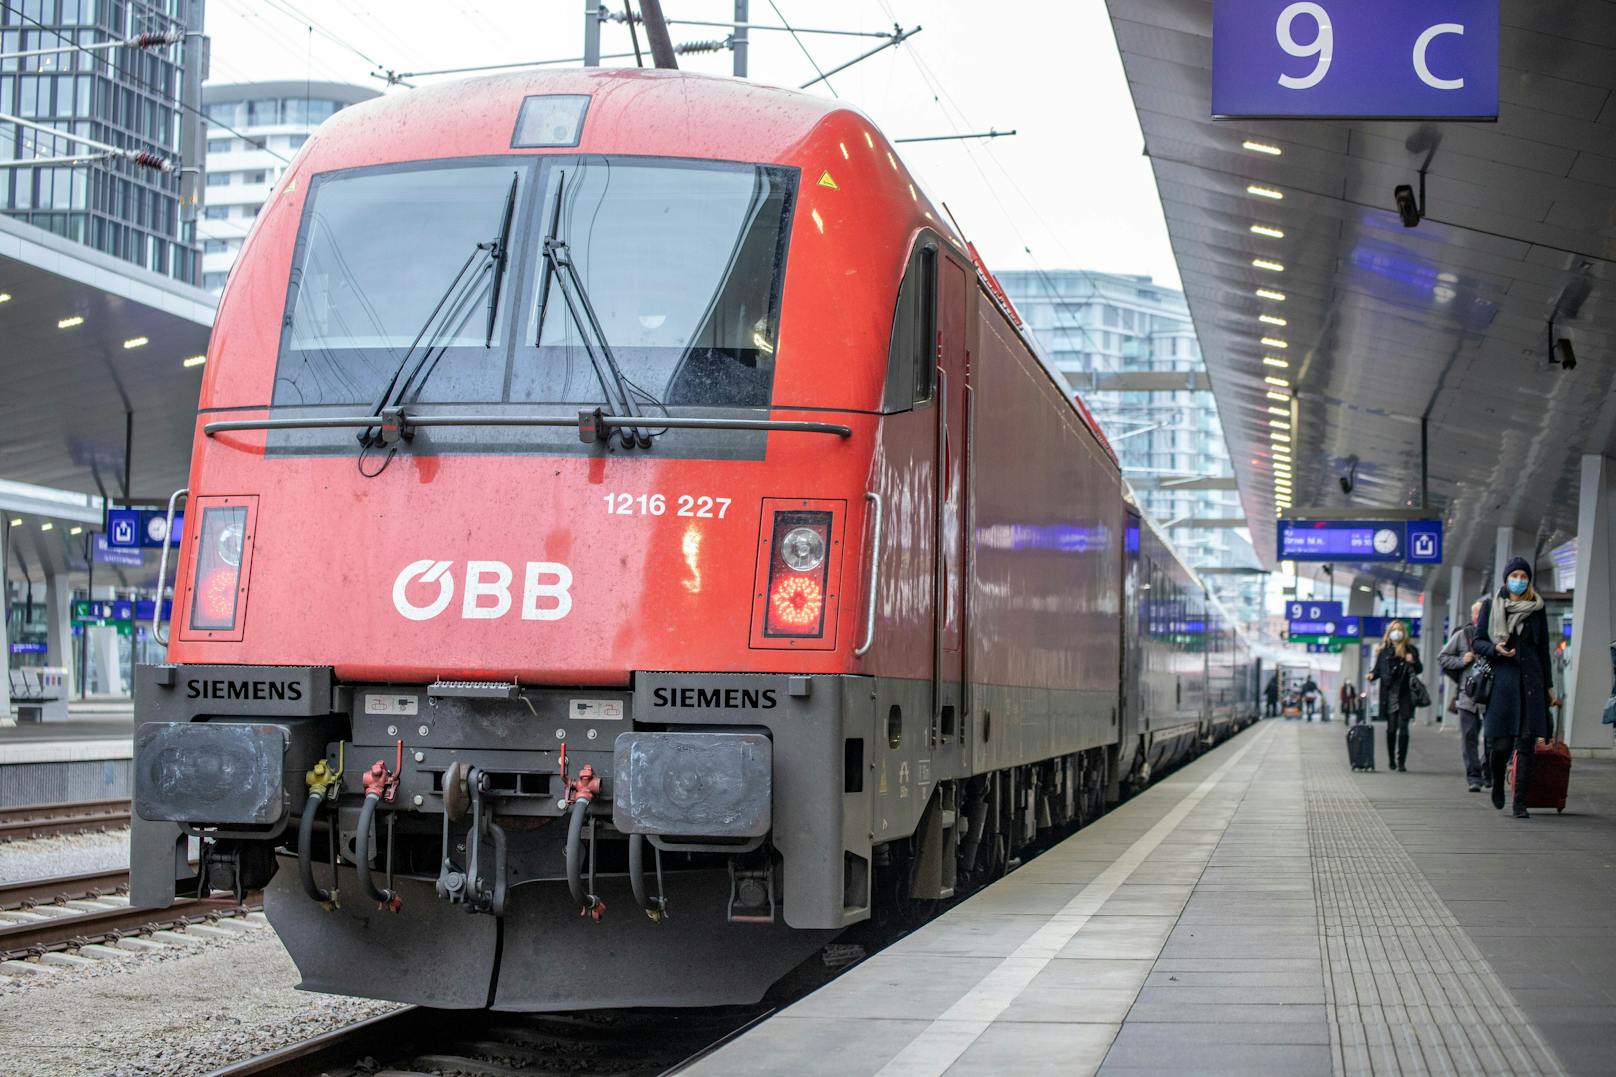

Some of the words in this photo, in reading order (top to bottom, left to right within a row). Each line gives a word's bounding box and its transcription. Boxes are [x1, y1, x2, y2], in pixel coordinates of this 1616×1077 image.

[1275, 1, 1334, 90] 9
[1412, 23, 1464, 90] C
[602, 491, 667, 516] 1216
[677, 494, 732, 519] 227
[392, 559, 574, 621] ÖBB
[1291, 604, 1303, 619] 9
[1310, 607, 1321, 619] D
[186, 679, 302, 701] SIEMENS
[653, 687, 777, 710] SIEMENS
